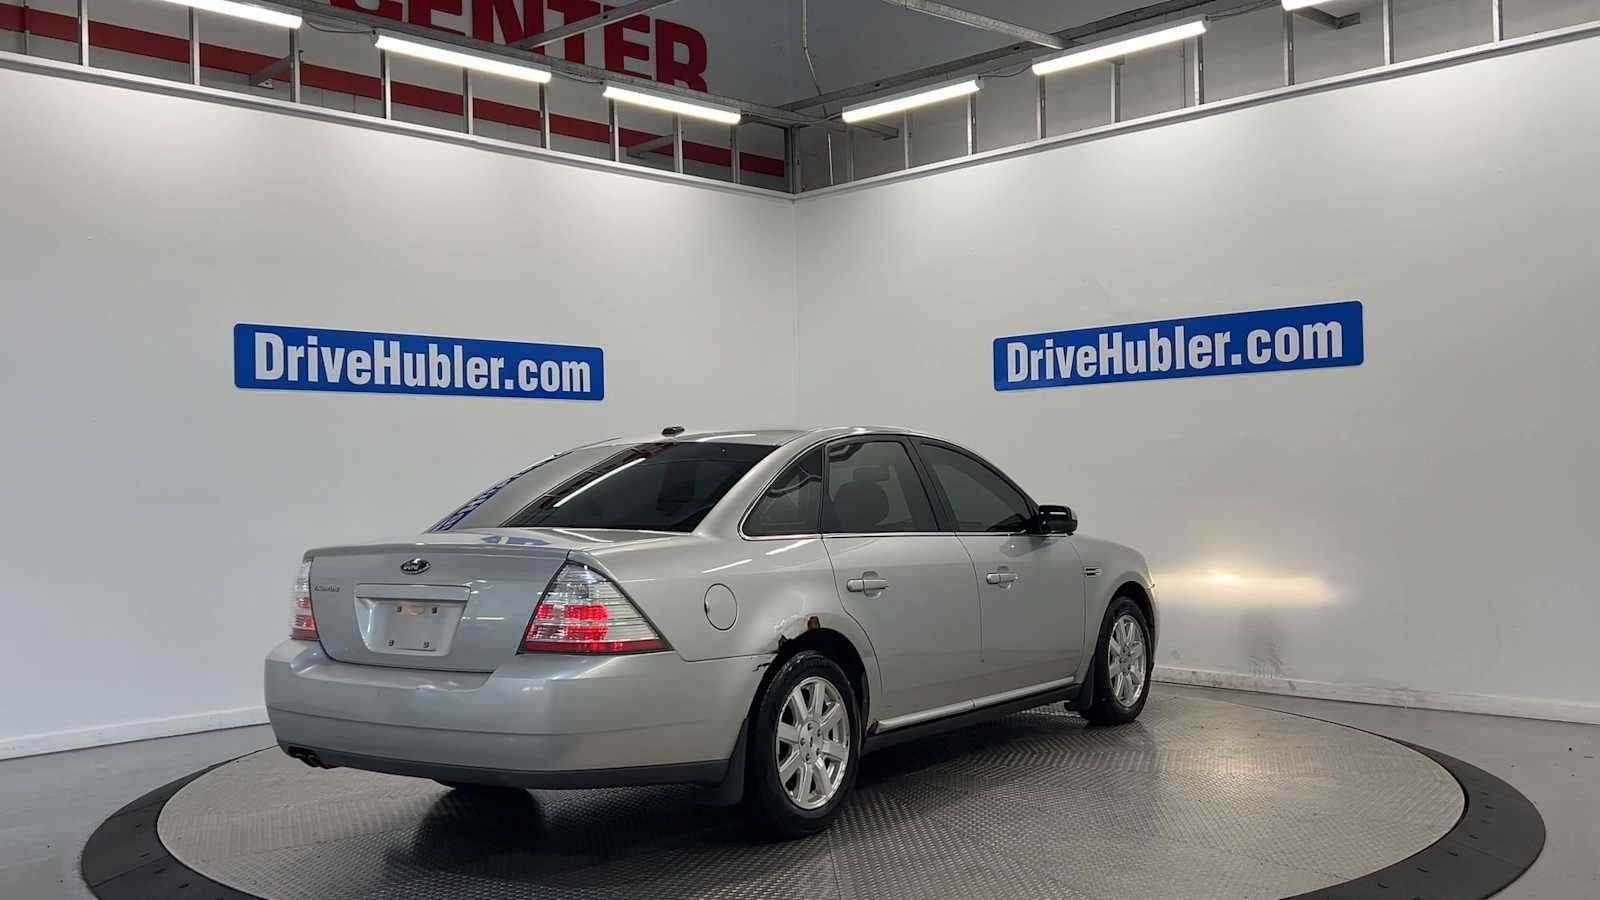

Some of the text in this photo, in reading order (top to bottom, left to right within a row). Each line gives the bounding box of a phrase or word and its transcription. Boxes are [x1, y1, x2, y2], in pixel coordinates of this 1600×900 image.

[328, 0, 708, 95] NTER
[254, 331, 592, 393] DriveHubler.com
[1007, 319, 1343, 383] DriveHubler.com
